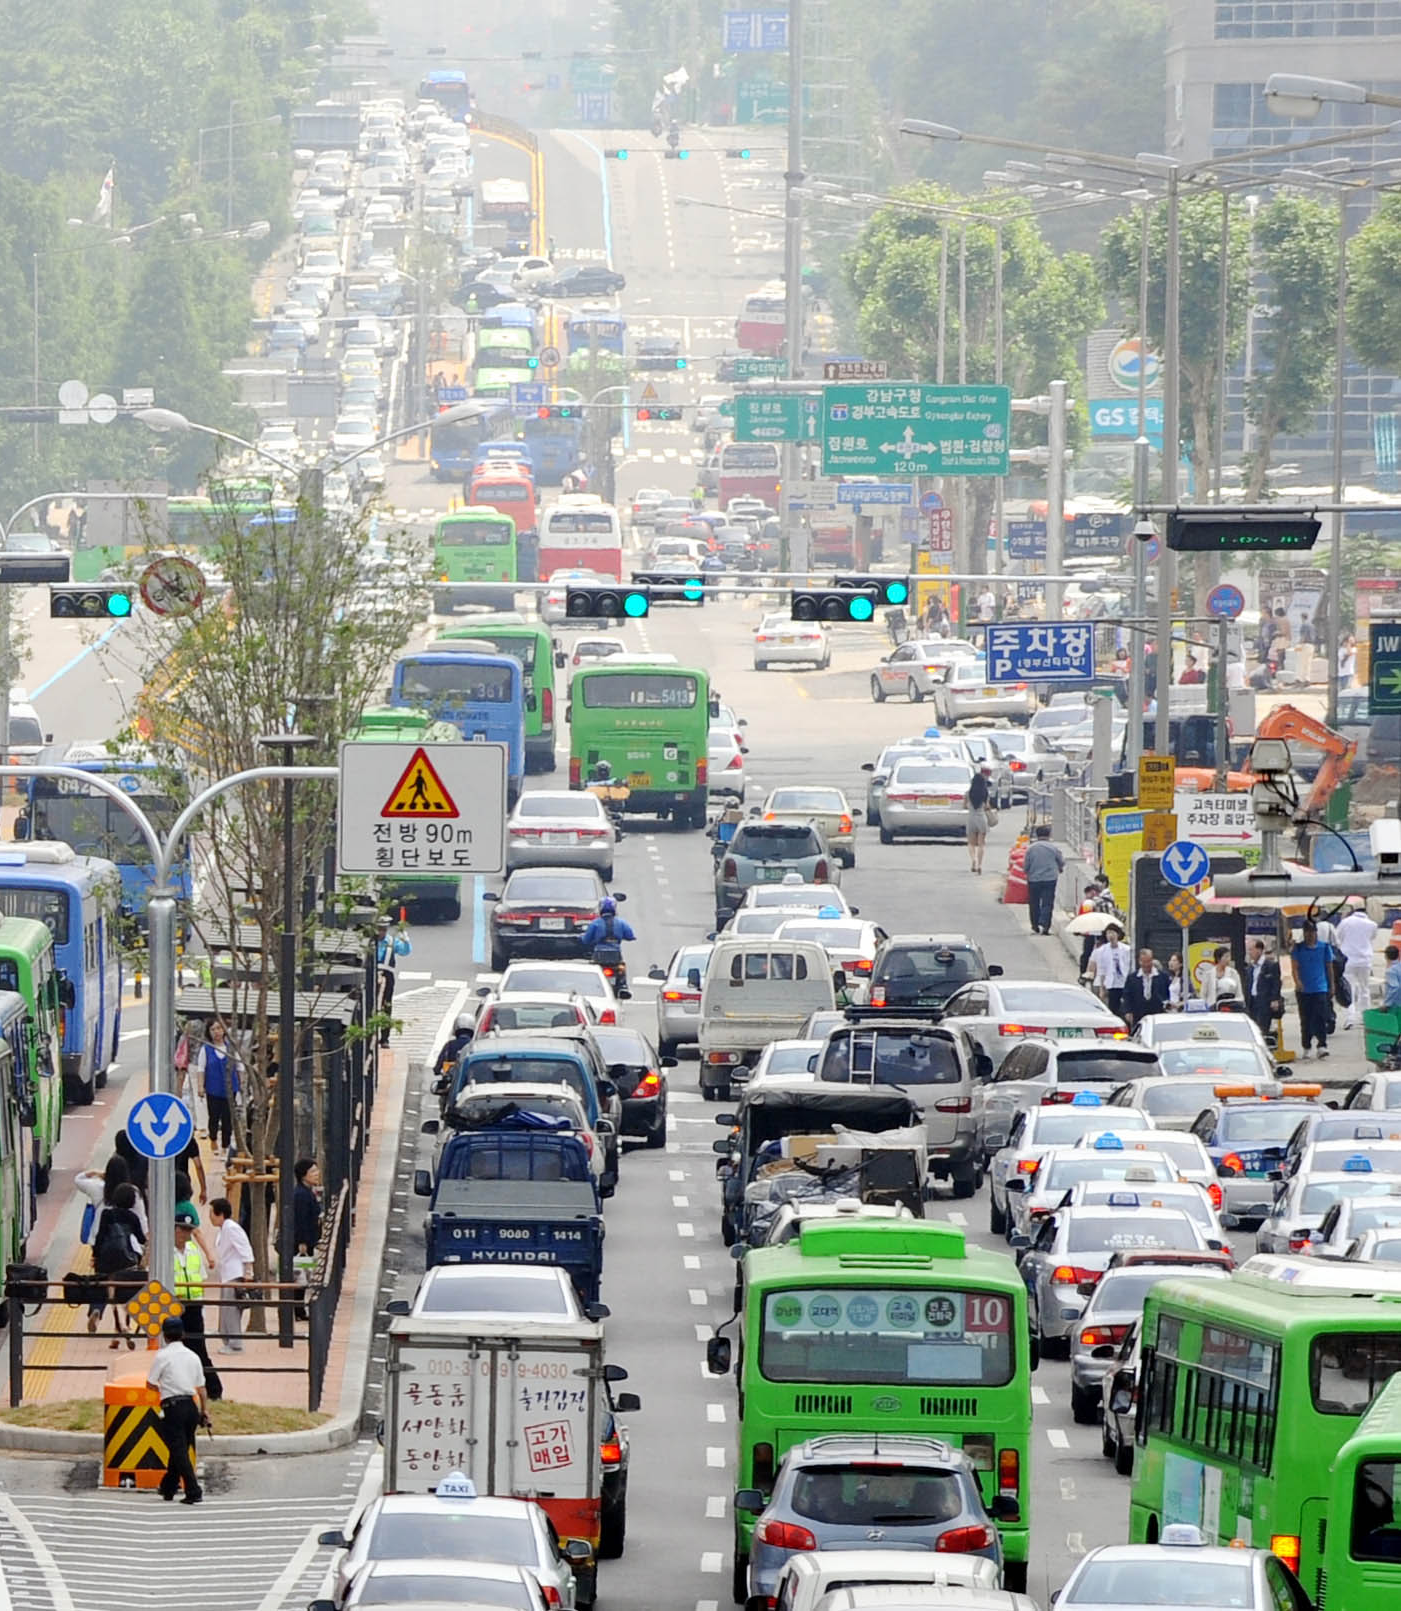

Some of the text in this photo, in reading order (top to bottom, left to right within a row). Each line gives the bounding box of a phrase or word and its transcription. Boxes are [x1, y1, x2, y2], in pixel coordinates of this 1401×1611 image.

[866, 388, 921, 403] 강남구청
[851, 405, 921, 420] 경부고속도로
[1094, 407, 1125, 427] GS
[893, 462, 928, 473] 120m
[992, 628, 1090, 658] 주차장
[995, 659, 1012, 678] P
[1192, 798, 1248, 811] 고속터미널
[1187, 813, 1220, 826] 주차장
[373, 822, 473, 844] 전방 90m
[375, 847, 473, 868] 횡단보도
[471, 1250, 557, 1261] HYUNDAI
[970, 1298, 1003, 1326] 10
[403, 1382, 466, 1407] 골동품
[401, 1416, 467, 1439] 서양화
[532, 1424, 567, 1446] 고가
[402, 1448, 467, 1472] 동양화
[533, 1445, 570, 1466] 매입
[444, 1484, 469, 1493] TAXI
